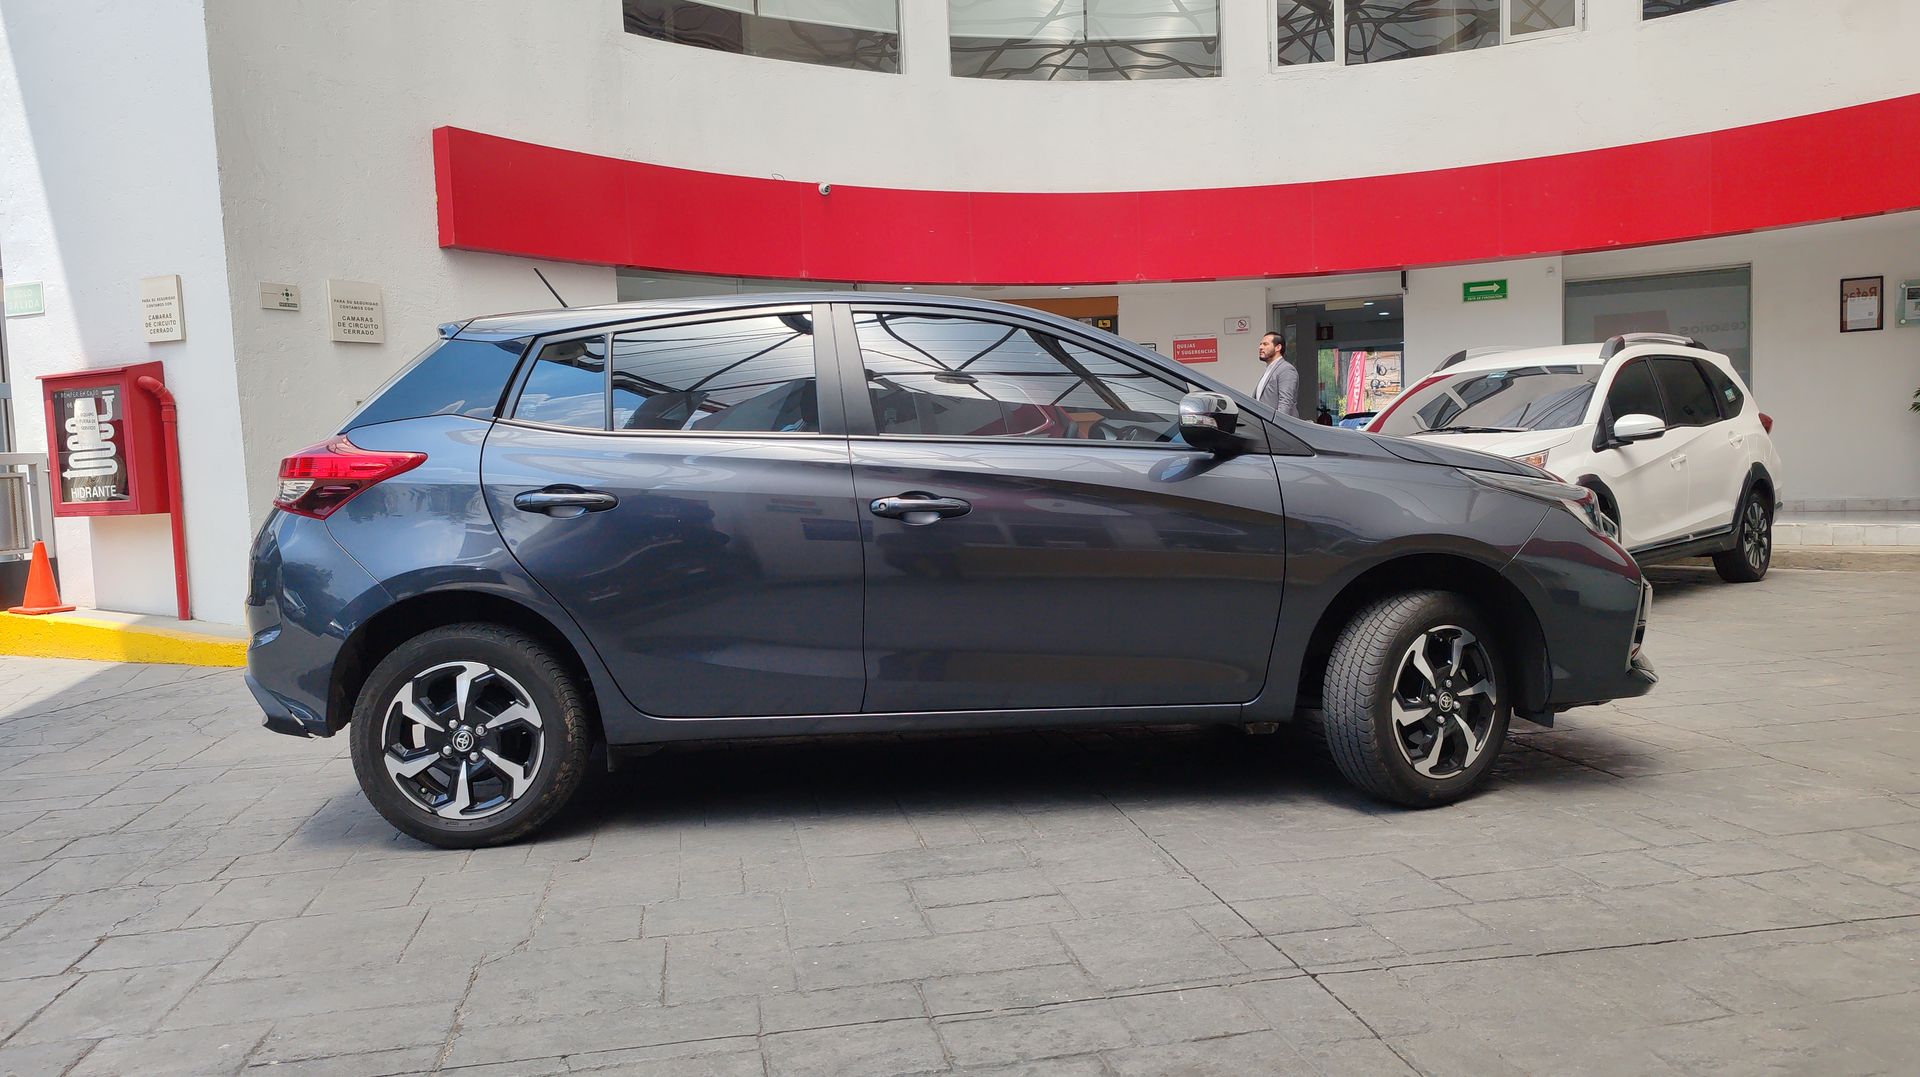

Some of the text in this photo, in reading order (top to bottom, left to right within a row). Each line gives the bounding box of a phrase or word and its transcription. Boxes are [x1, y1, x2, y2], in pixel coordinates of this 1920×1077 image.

[7, 298, 41, 311] SALIDA
[148, 313, 172, 321] CAMARAS
[341, 315, 374, 323] CAMARAS
[153, 319, 177, 327] CIRCUITO
[348, 322, 379, 330] CIRCUITO
[150, 327, 174, 335] CERRADO
[342, 328, 375, 336] CERRADO
[1181, 348, 1216, 356] SUGERENCIAS
[71, 485, 117, 499] HIDRANTE
